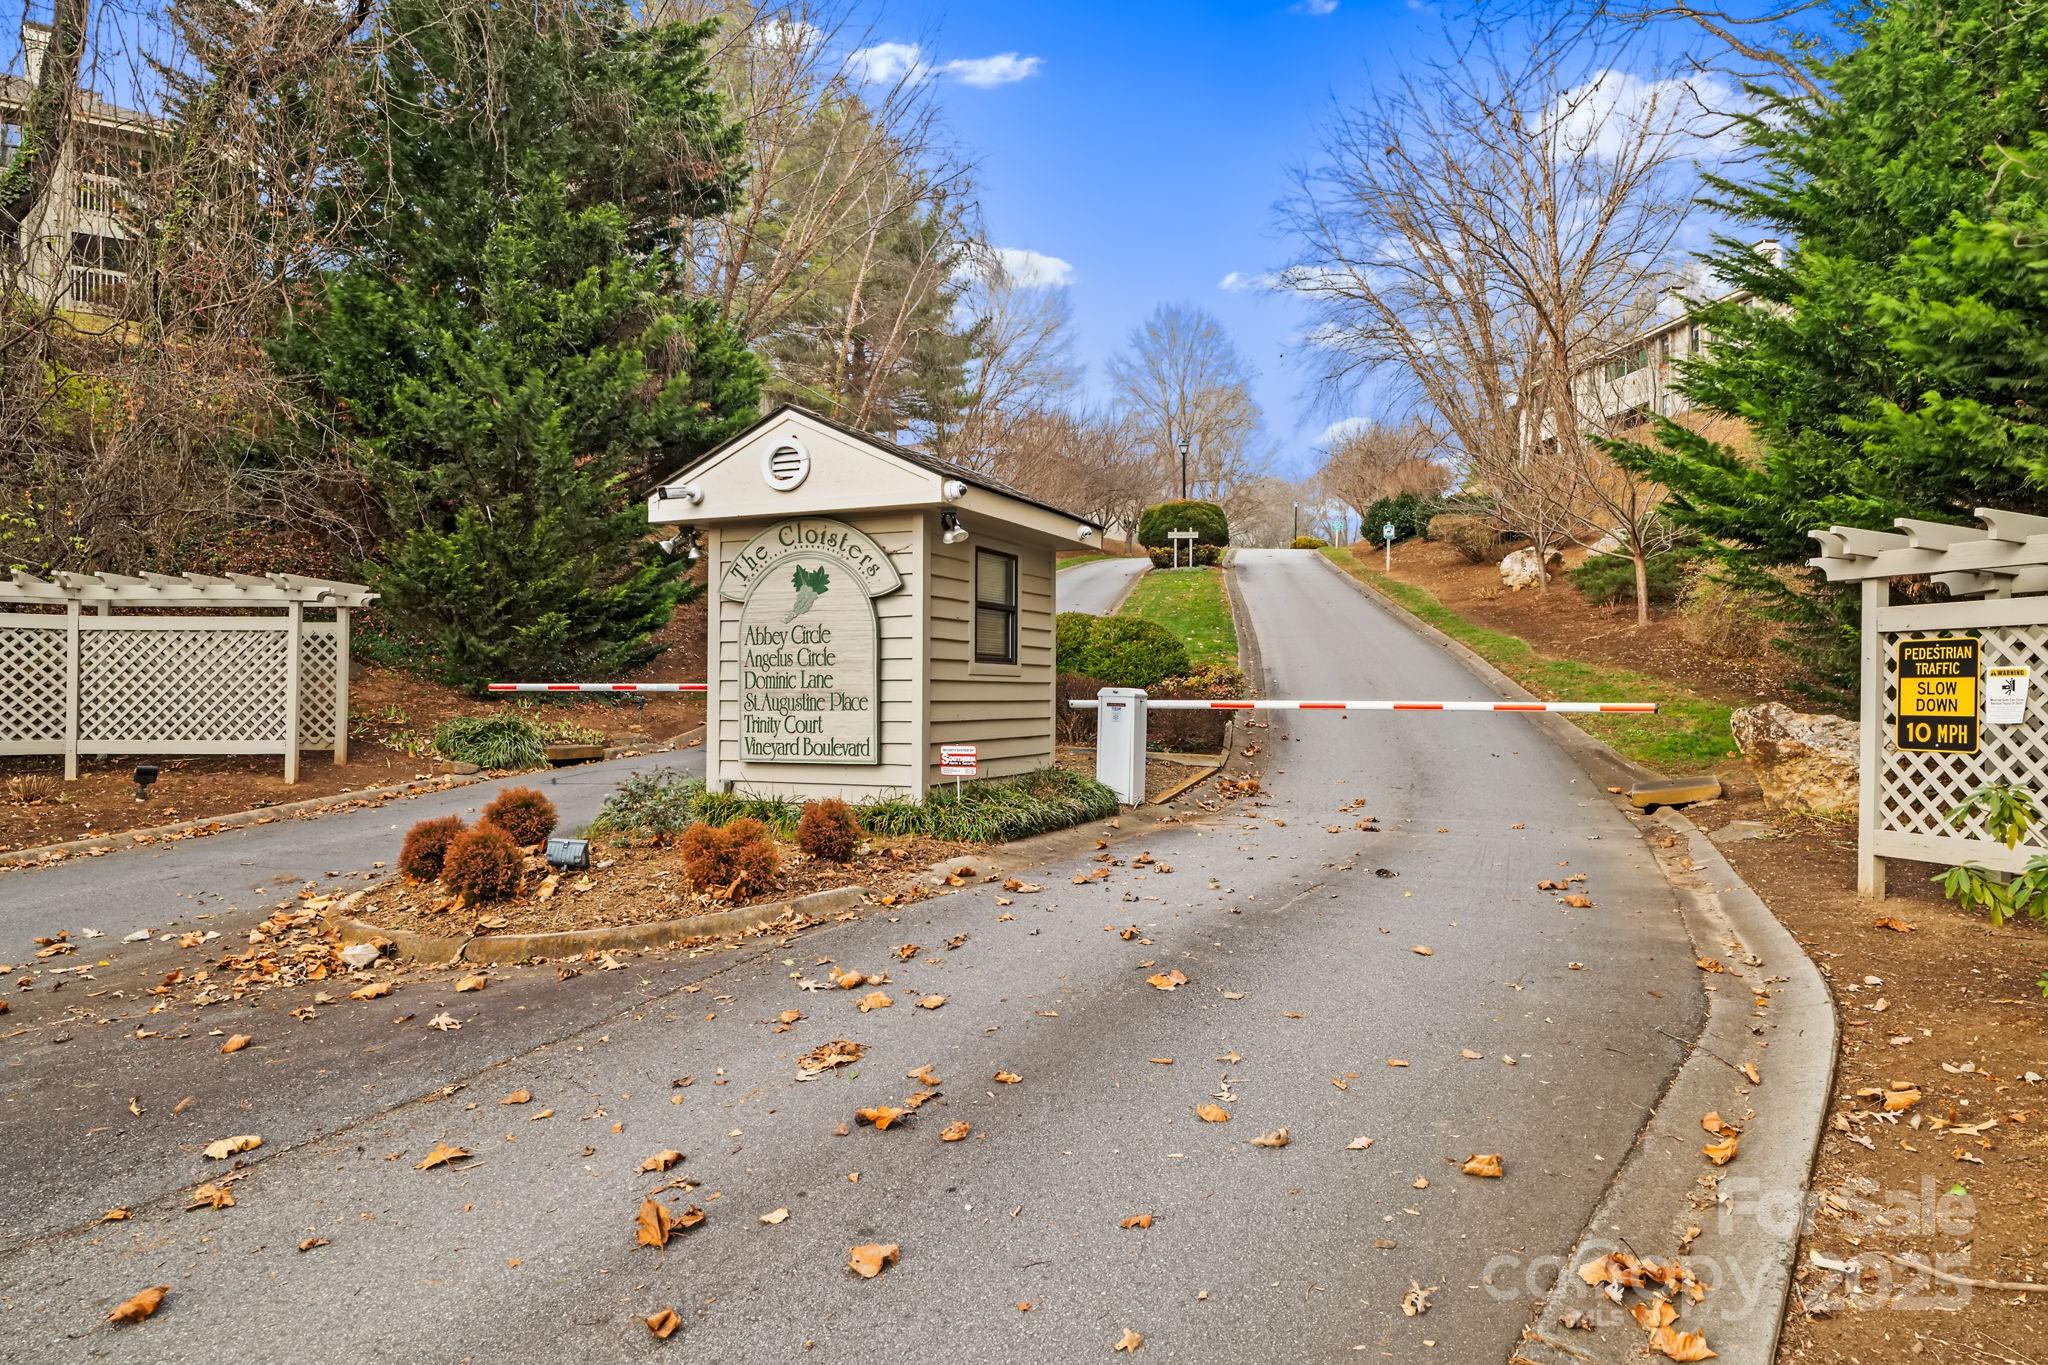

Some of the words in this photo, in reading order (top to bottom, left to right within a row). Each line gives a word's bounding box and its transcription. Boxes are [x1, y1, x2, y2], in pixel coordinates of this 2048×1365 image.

[730, 544, 768, 583] The
[778, 523, 880, 577] Cloisters
[744, 625, 788, 650] Abbey
[791, 624, 831, 644] Circle
[744, 650, 794, 672] Angelus
[796, 648, 836, 666] Circle
[1904, 646, 1972, 660] PEDESTRIAN
[1916, 662, 1960, 675] TRAFFIC
[744, 671, 796, 690] Dominic
[800, 670, 834, 689] Lane
[1917, 682, 1957, 695] SLOW
[830, 692, 868, 712] Place
[1916, 698, 1958, 712] DOWN
[744, 715, 781, 738] Trinity
[784, 715, 824, 734] Court
[1907, 723, 1931, 742] 10
[1938, 724, 1968, 744] MPH
[744, 737, 800, 760] Vineyard
[803, 737, 870, 757] Boulevard
